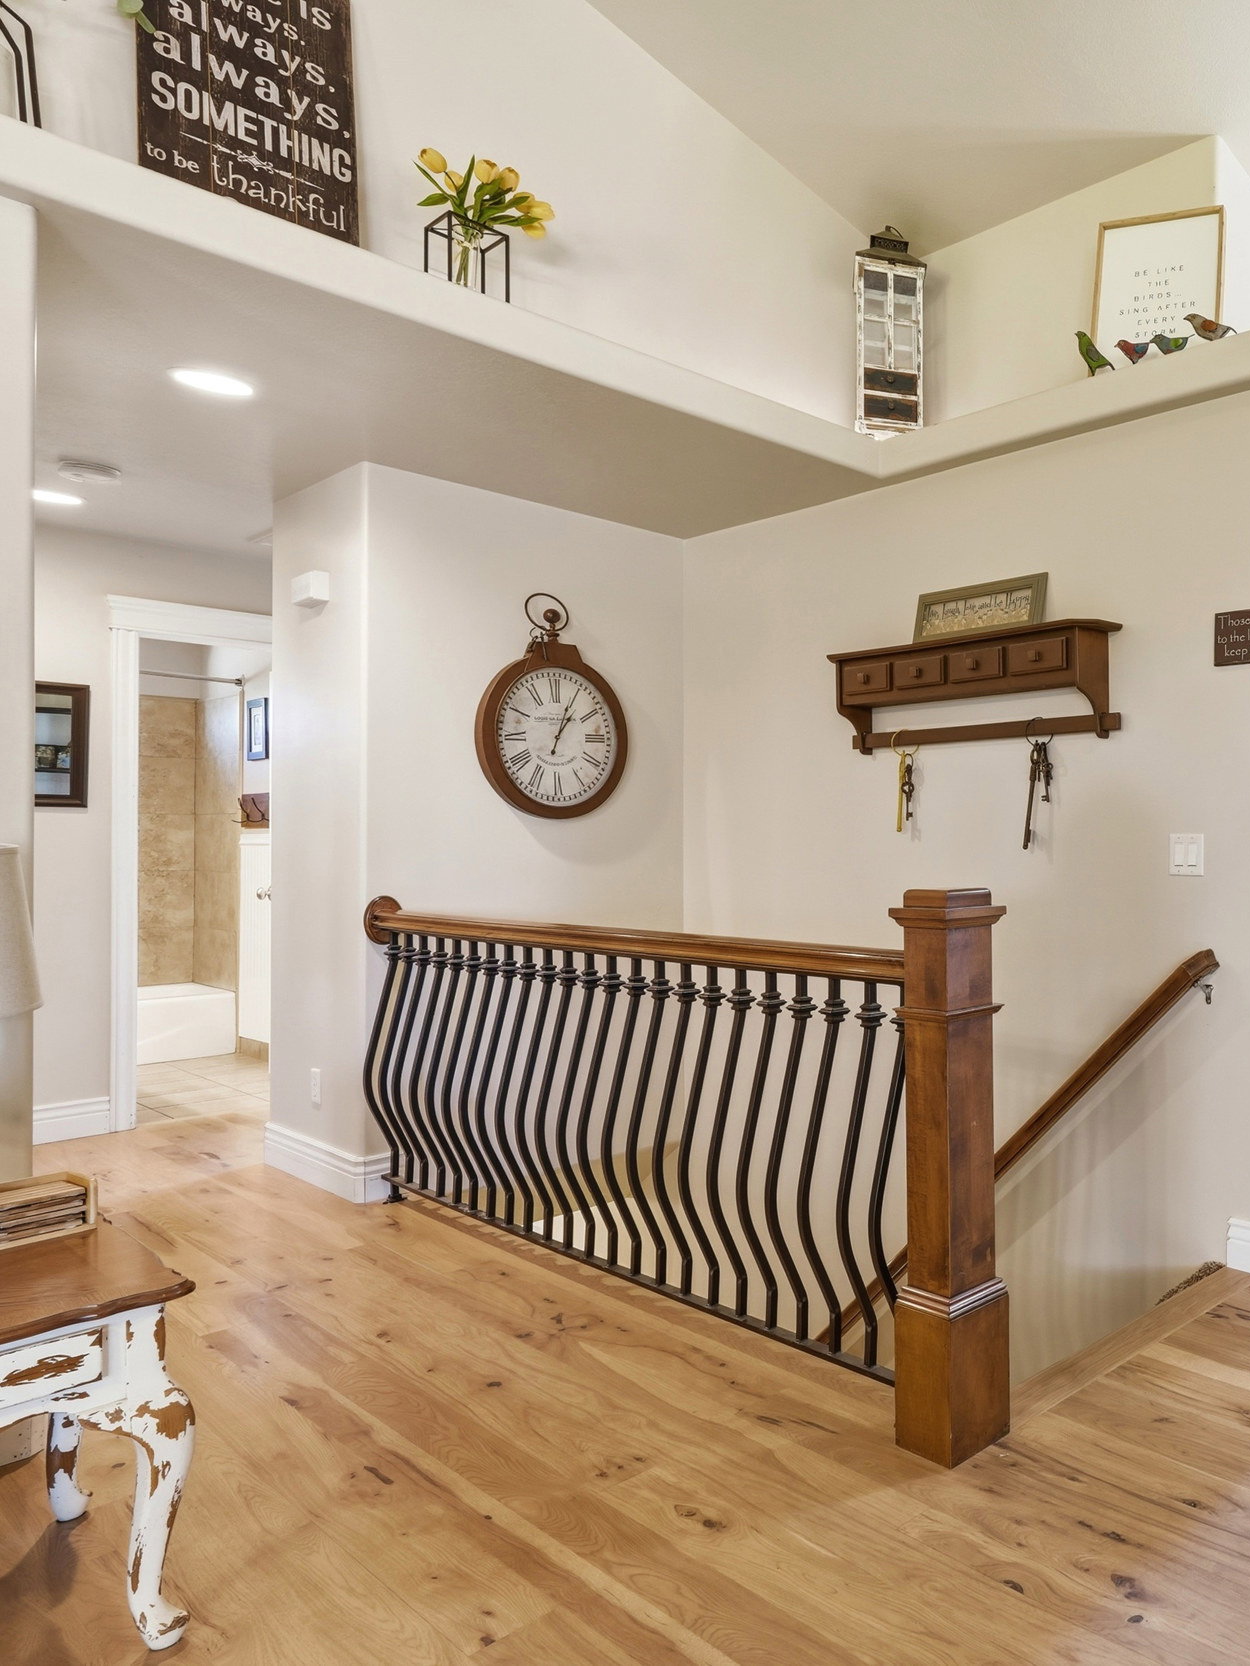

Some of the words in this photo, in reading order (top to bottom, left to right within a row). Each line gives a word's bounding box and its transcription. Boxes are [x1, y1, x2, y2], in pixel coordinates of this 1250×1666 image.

[167, 0, 336, 92] always.
[152, 29, 351, 139] always.
[150, 70, 353, 183] SOMETHING
[144, 140, 167, 161] to
[173, 150, 200, 174] be
[211, 154, 347, 232] thankful
[1134, 269, 1148, 277] BE
[1157, 264, 1184, 275] LIKE
[1148, 279, 1169, 287] THE
[1119, 307, 1148, 316] SING
[1157, 301, 1196, 311] AFTER
[1137, 315, 1176, 326] EVERY
[1134, 328, 1176, 339] STORM
[1217, 614, 1250, 630] Those
[1217, 635, 1228, 644] to
[1230, 630, 1246, 643] the
[1224, 644, 1248, 660] keep
